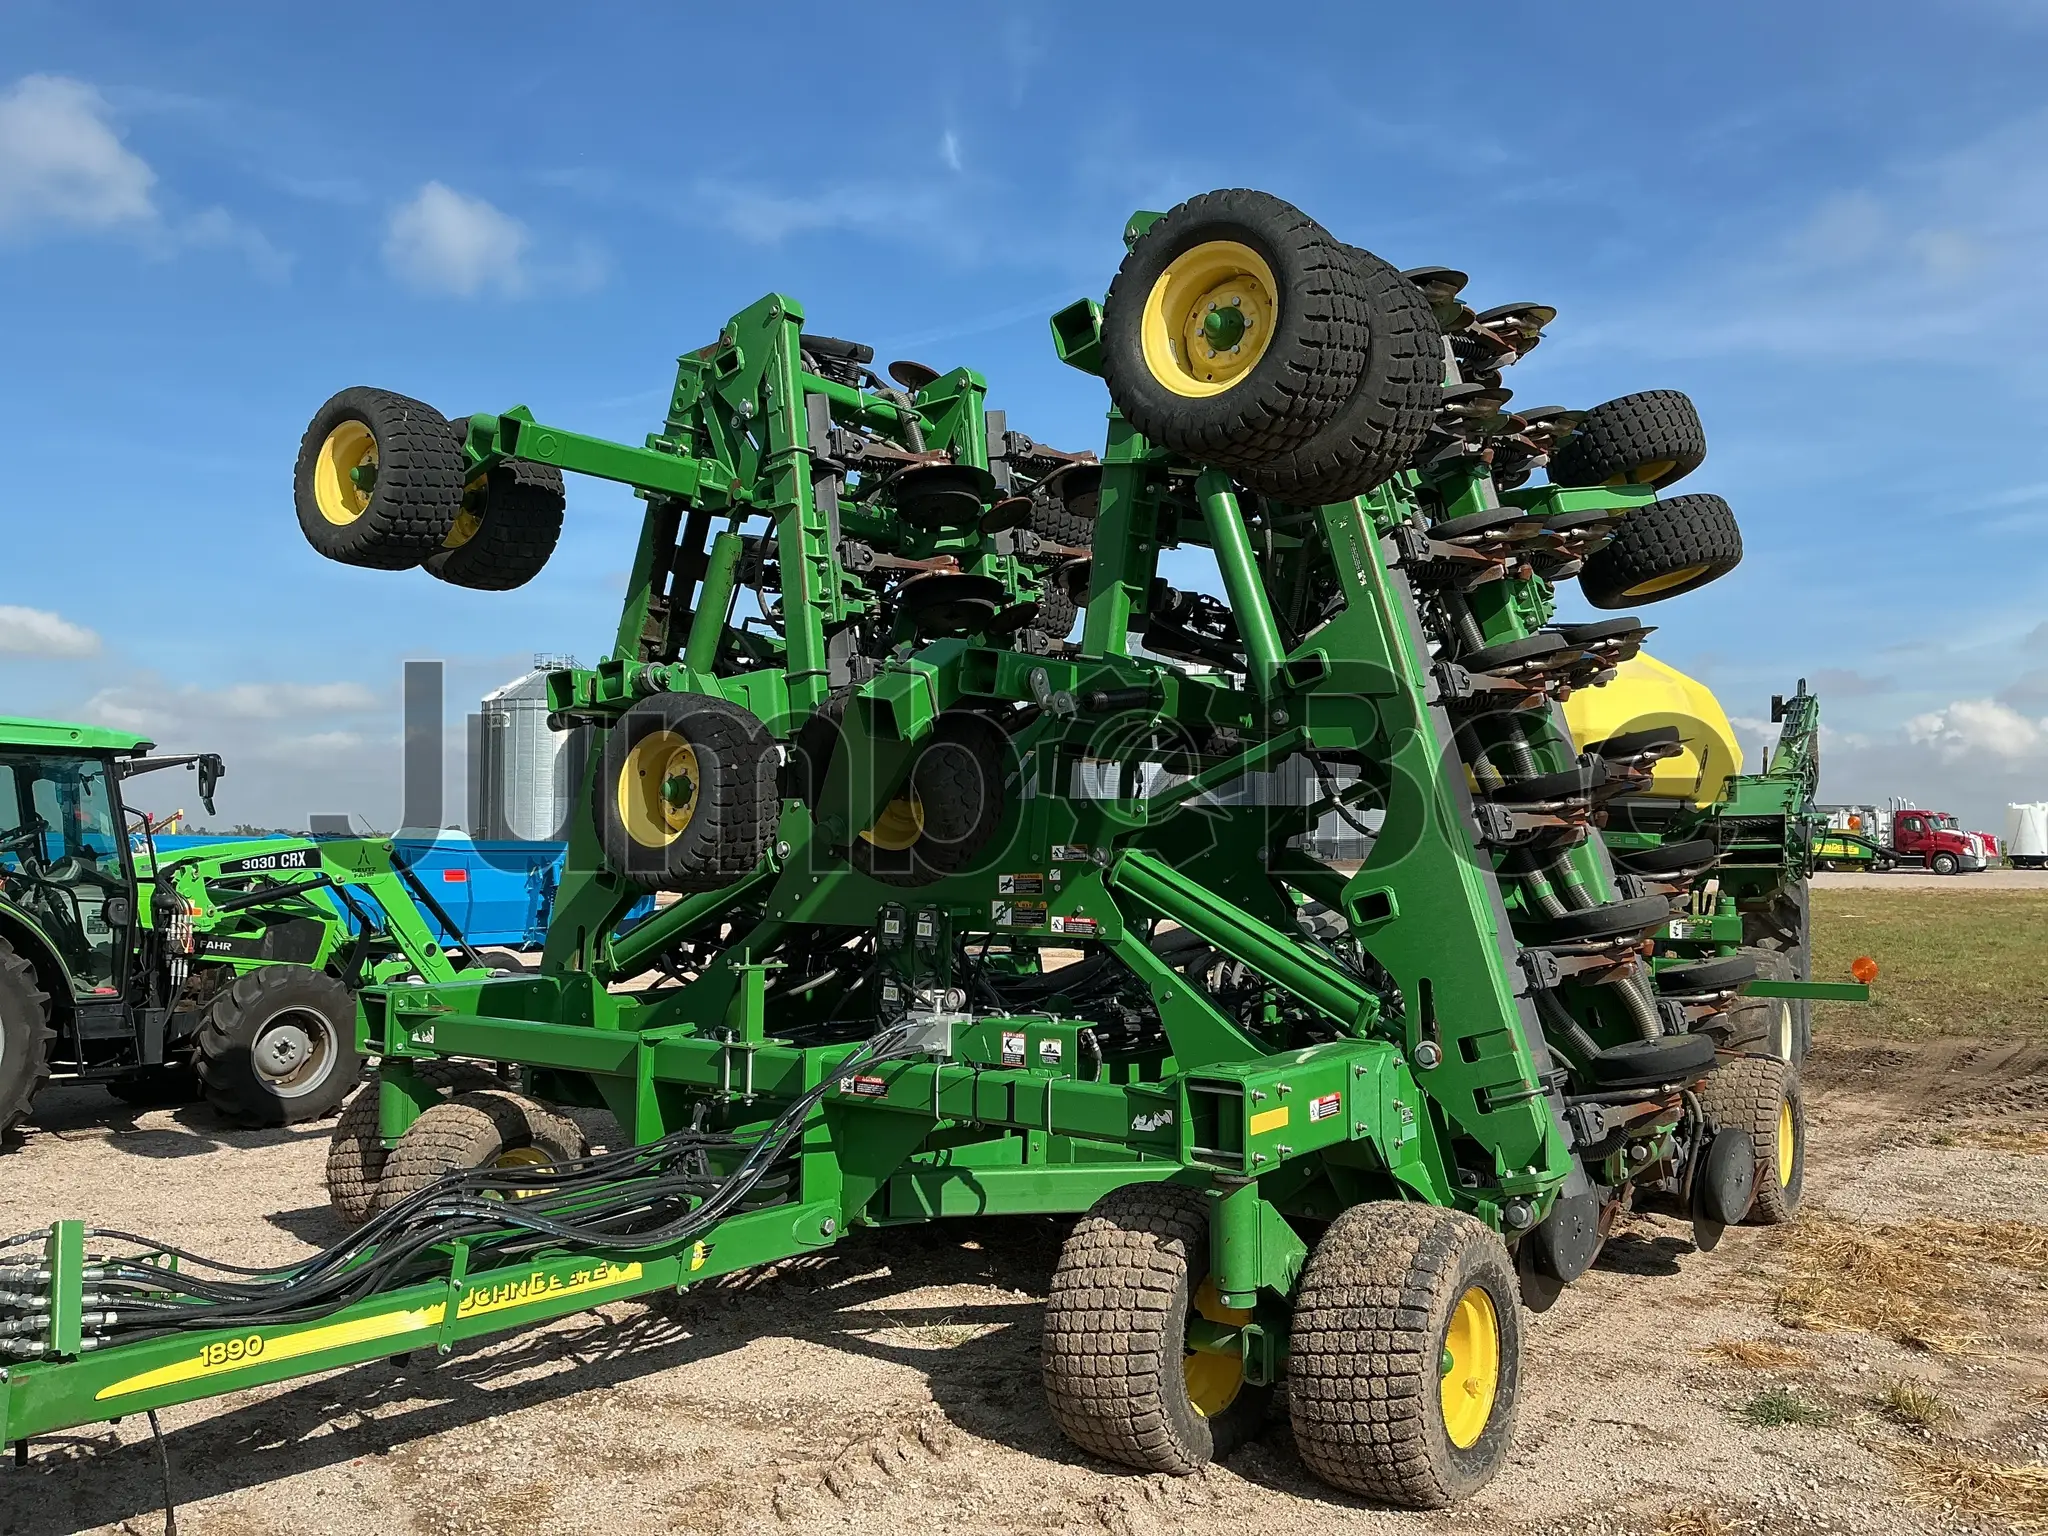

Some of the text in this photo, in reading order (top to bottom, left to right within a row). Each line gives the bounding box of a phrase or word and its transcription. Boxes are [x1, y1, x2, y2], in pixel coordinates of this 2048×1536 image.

[242, 851, 306, 870] 3030 CRX
[200, 940, 232, 951] FAHR
[200, 1334, 264, 1368] 1890
